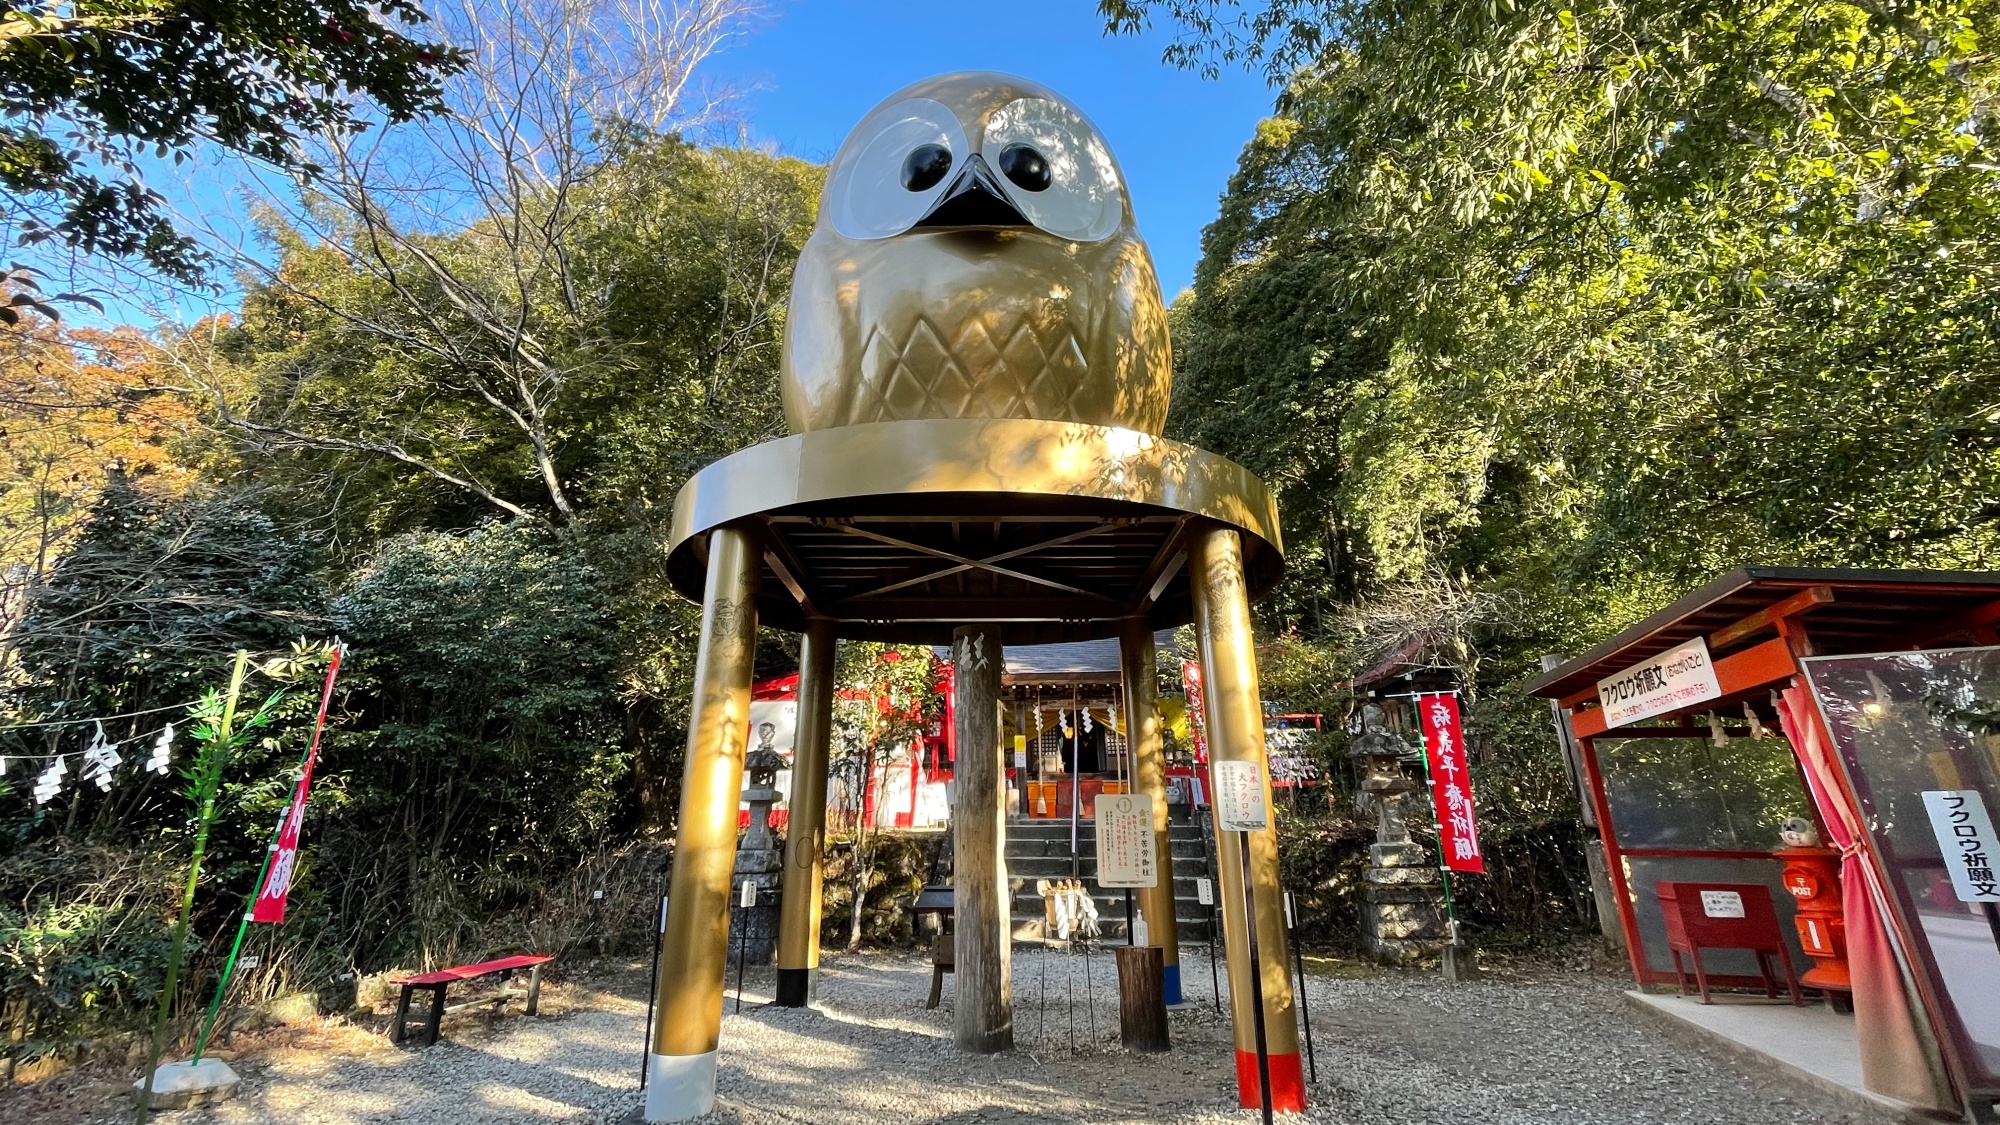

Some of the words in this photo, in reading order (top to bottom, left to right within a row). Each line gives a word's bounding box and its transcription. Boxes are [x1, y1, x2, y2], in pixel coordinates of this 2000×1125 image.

[1602, 663, 1668, 706] フクロウ祈願文
[1238, 772, 1250, 820] 大フクロウ
[1249, 766, 1260, 804] 日本一の
[1942, 797, 2000, 896] フクロウ祈願文
[1791, 886, 1811, 897] POST
